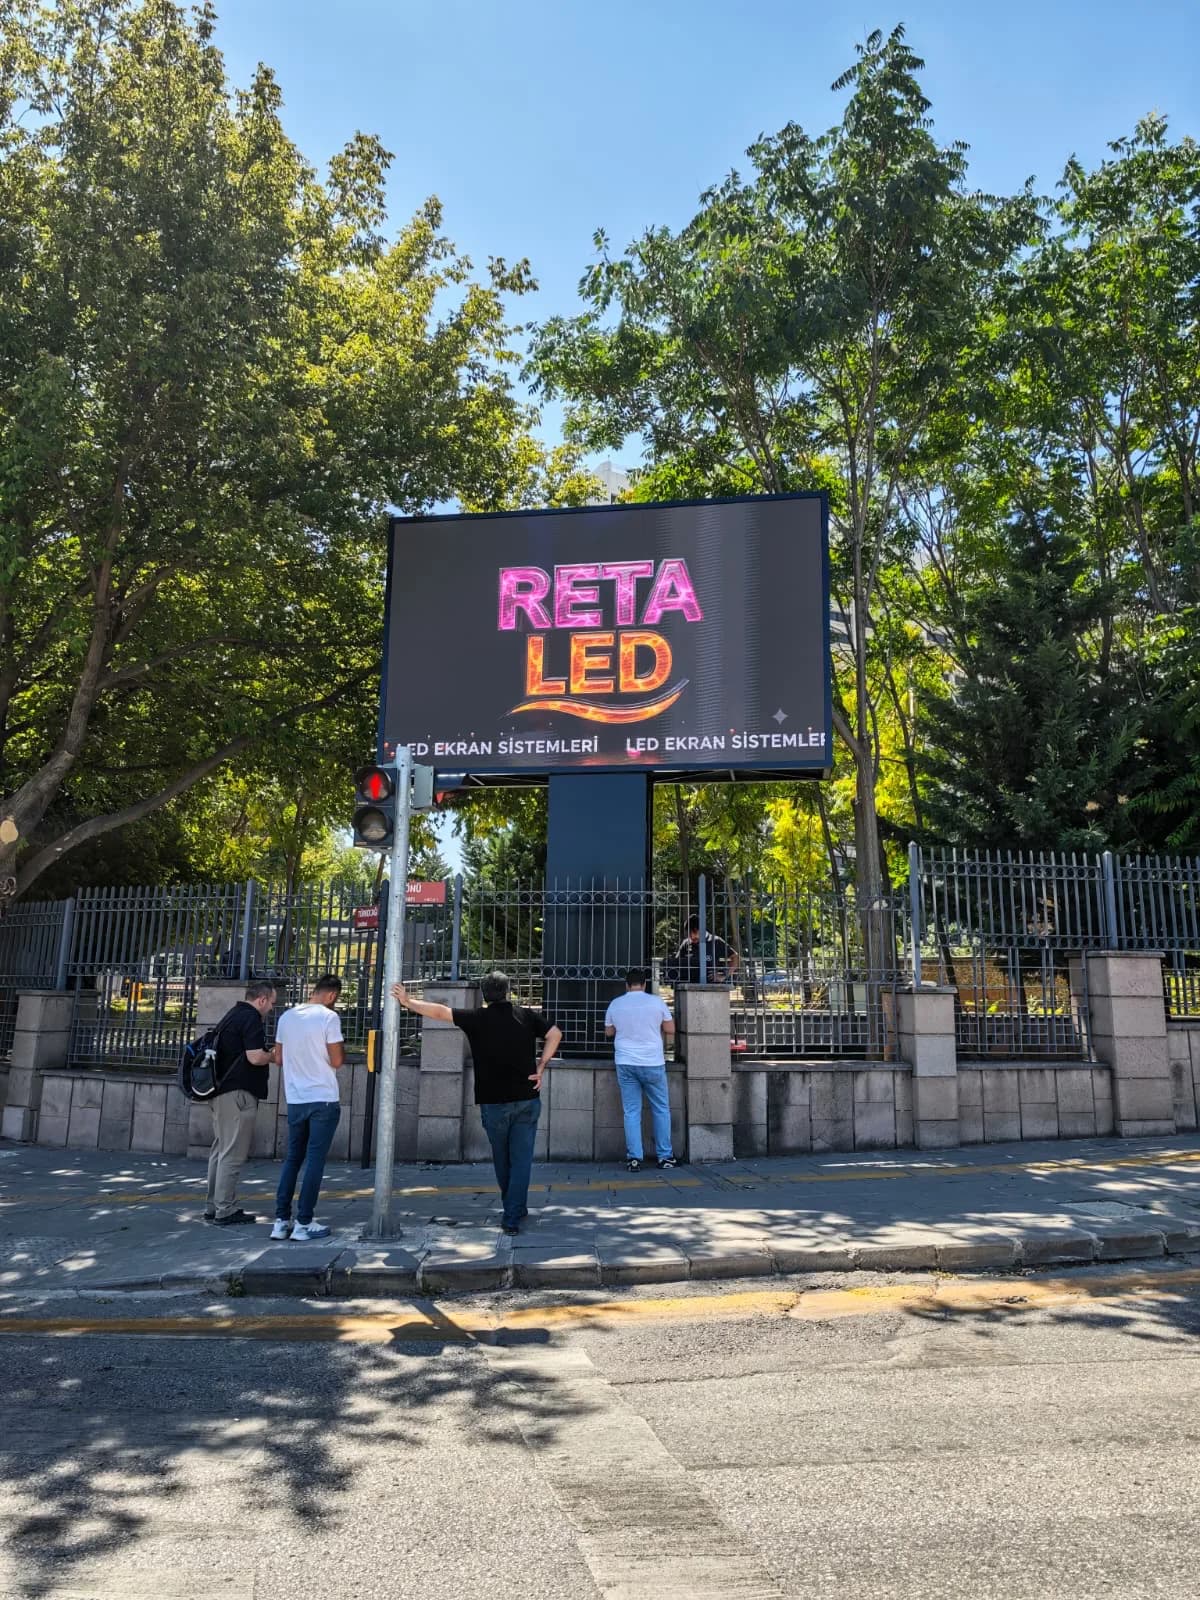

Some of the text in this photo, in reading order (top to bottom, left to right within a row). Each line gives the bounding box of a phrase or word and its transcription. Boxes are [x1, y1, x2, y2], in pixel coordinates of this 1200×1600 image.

[498, 558, 704, 630] RETA
[525, 630, 673, 696] LED
[397, 735, 598, 756] ED EKRAN SİSTEMLERİ
[626, 737, 659, 751] LED
[665, 735, 725, 750] EKRAN
